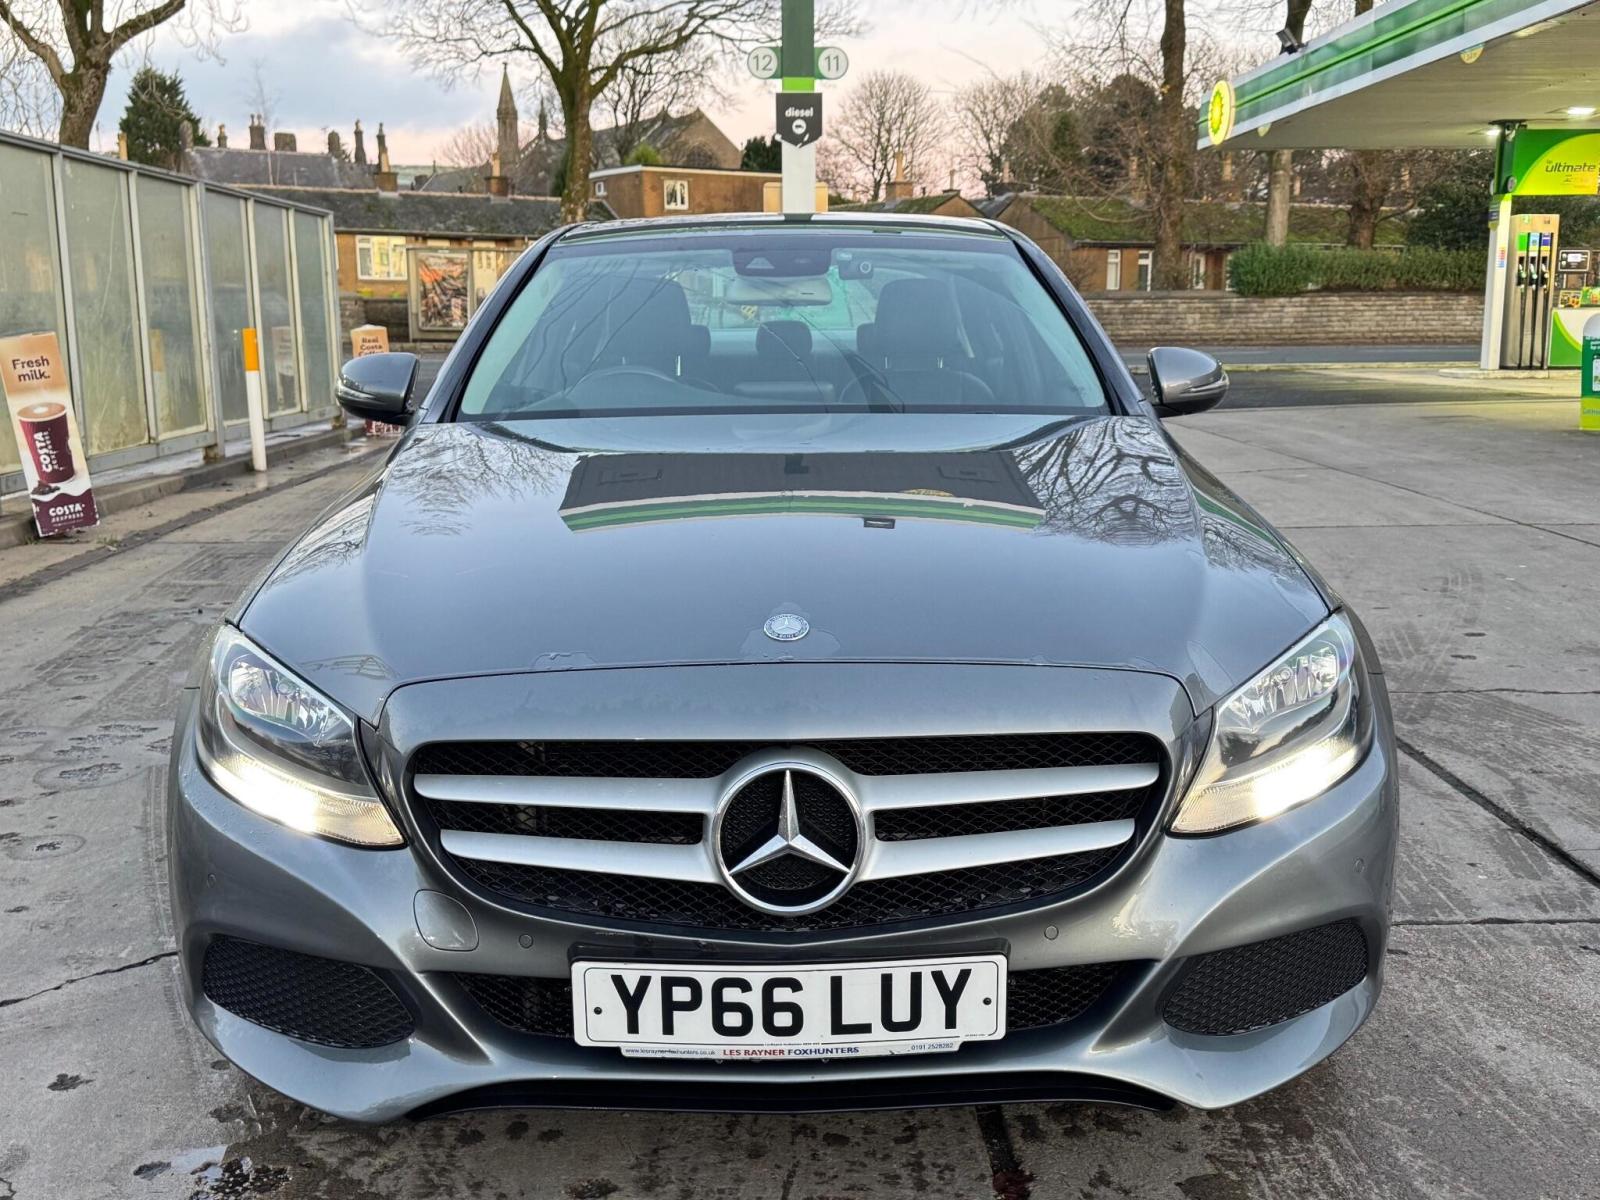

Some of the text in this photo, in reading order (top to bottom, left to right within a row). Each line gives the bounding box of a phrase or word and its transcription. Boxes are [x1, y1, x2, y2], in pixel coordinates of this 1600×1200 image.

[753, 54, 773, 72] 12
[824, 54, 840, 72] 11
[785, 106, 814, 118] diesel
[1545, 161, 1596, 173] ultimate
[12, 355, 50, 370] Fresh
[18, 369, 51, 382] milk.
[33, 431, 53, 473] COSTA
[48, 503, 82, 517] COSTA
[610, 968, 972, 1037] YP66 LUY
[787, 1046, 860, 1056] FOXHUNTERS
